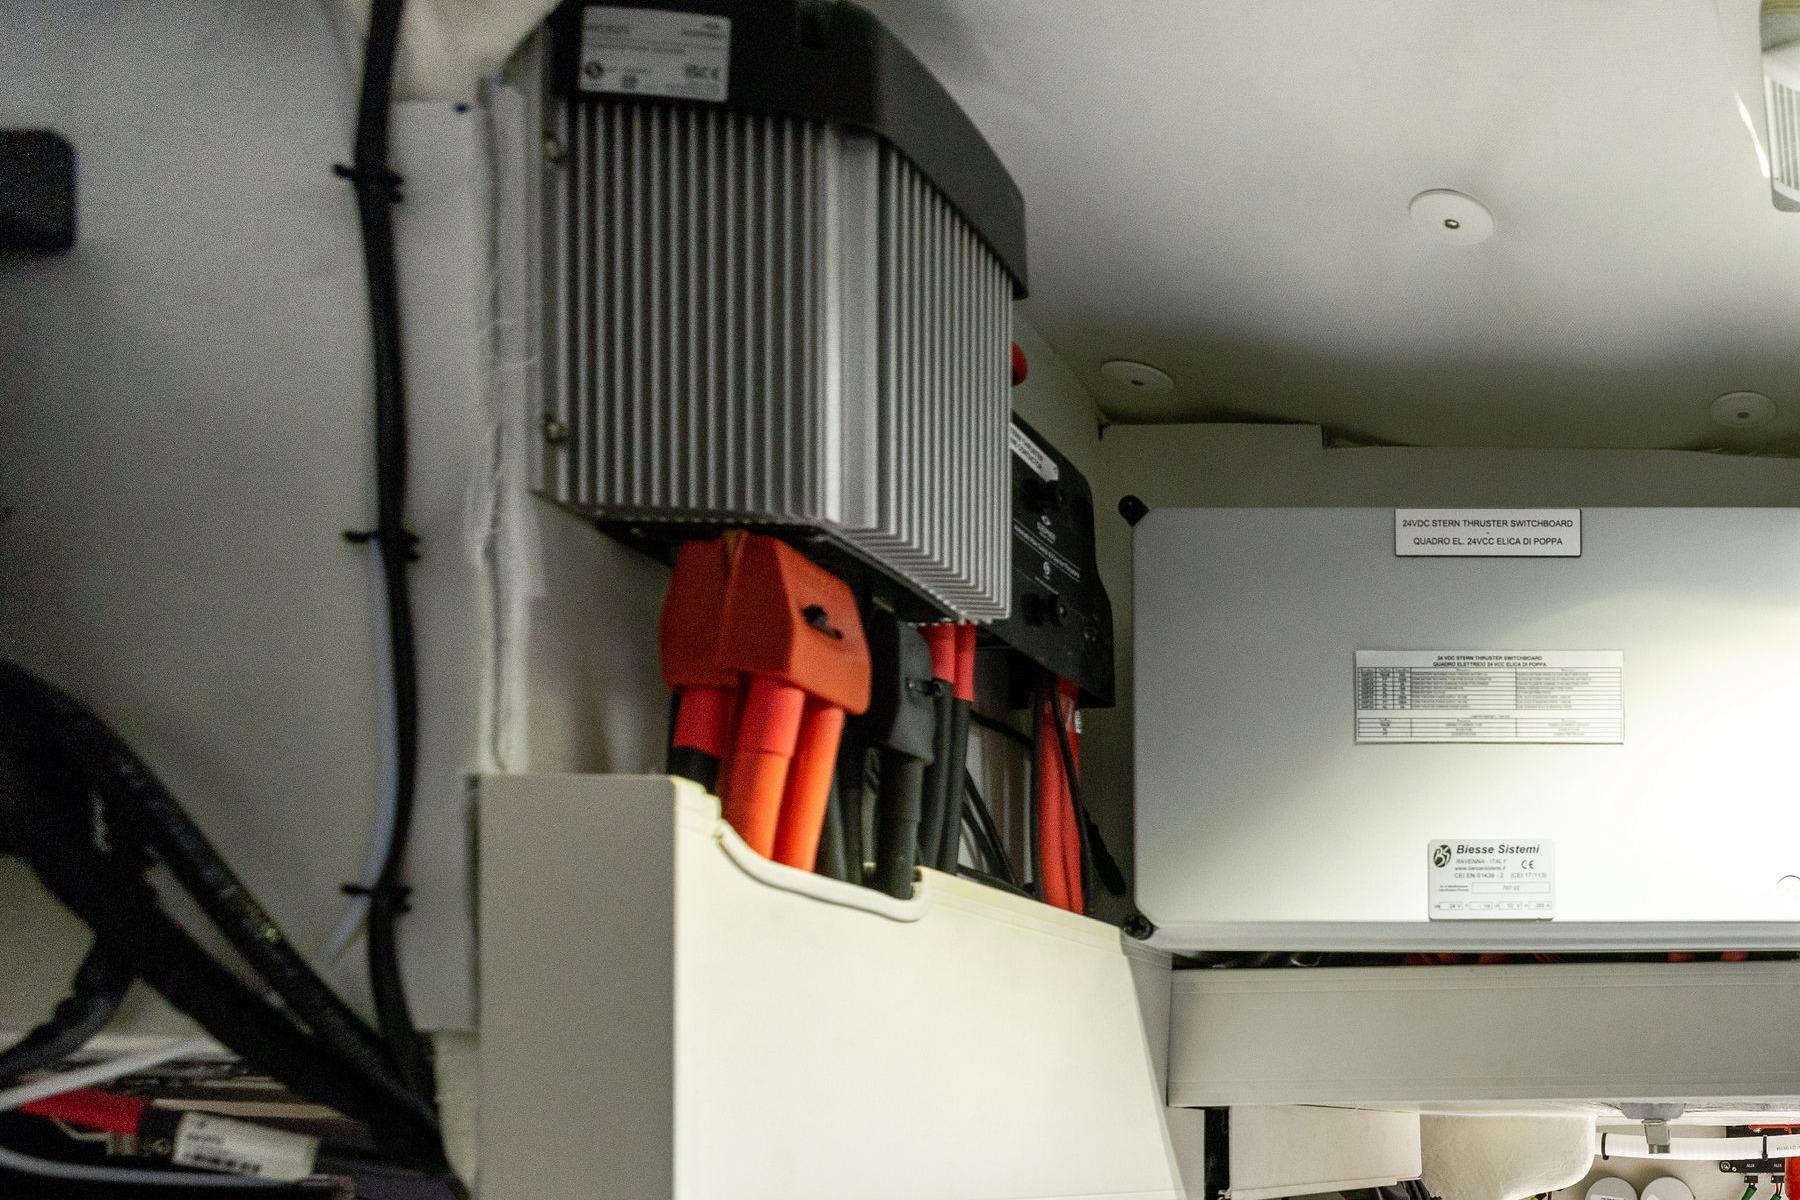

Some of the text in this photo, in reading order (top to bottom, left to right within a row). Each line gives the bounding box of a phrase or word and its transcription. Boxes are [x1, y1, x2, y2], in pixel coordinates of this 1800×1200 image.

[1402, 519, 1574, 528] 24VDC STERN THRUSTER SWITCHBOARD
[1413, 537, 1563, 546] QUADRO EL. 24VCC ELICA DI POPPA
[1456, 844, 1540, 854] Biesse Sistemi
